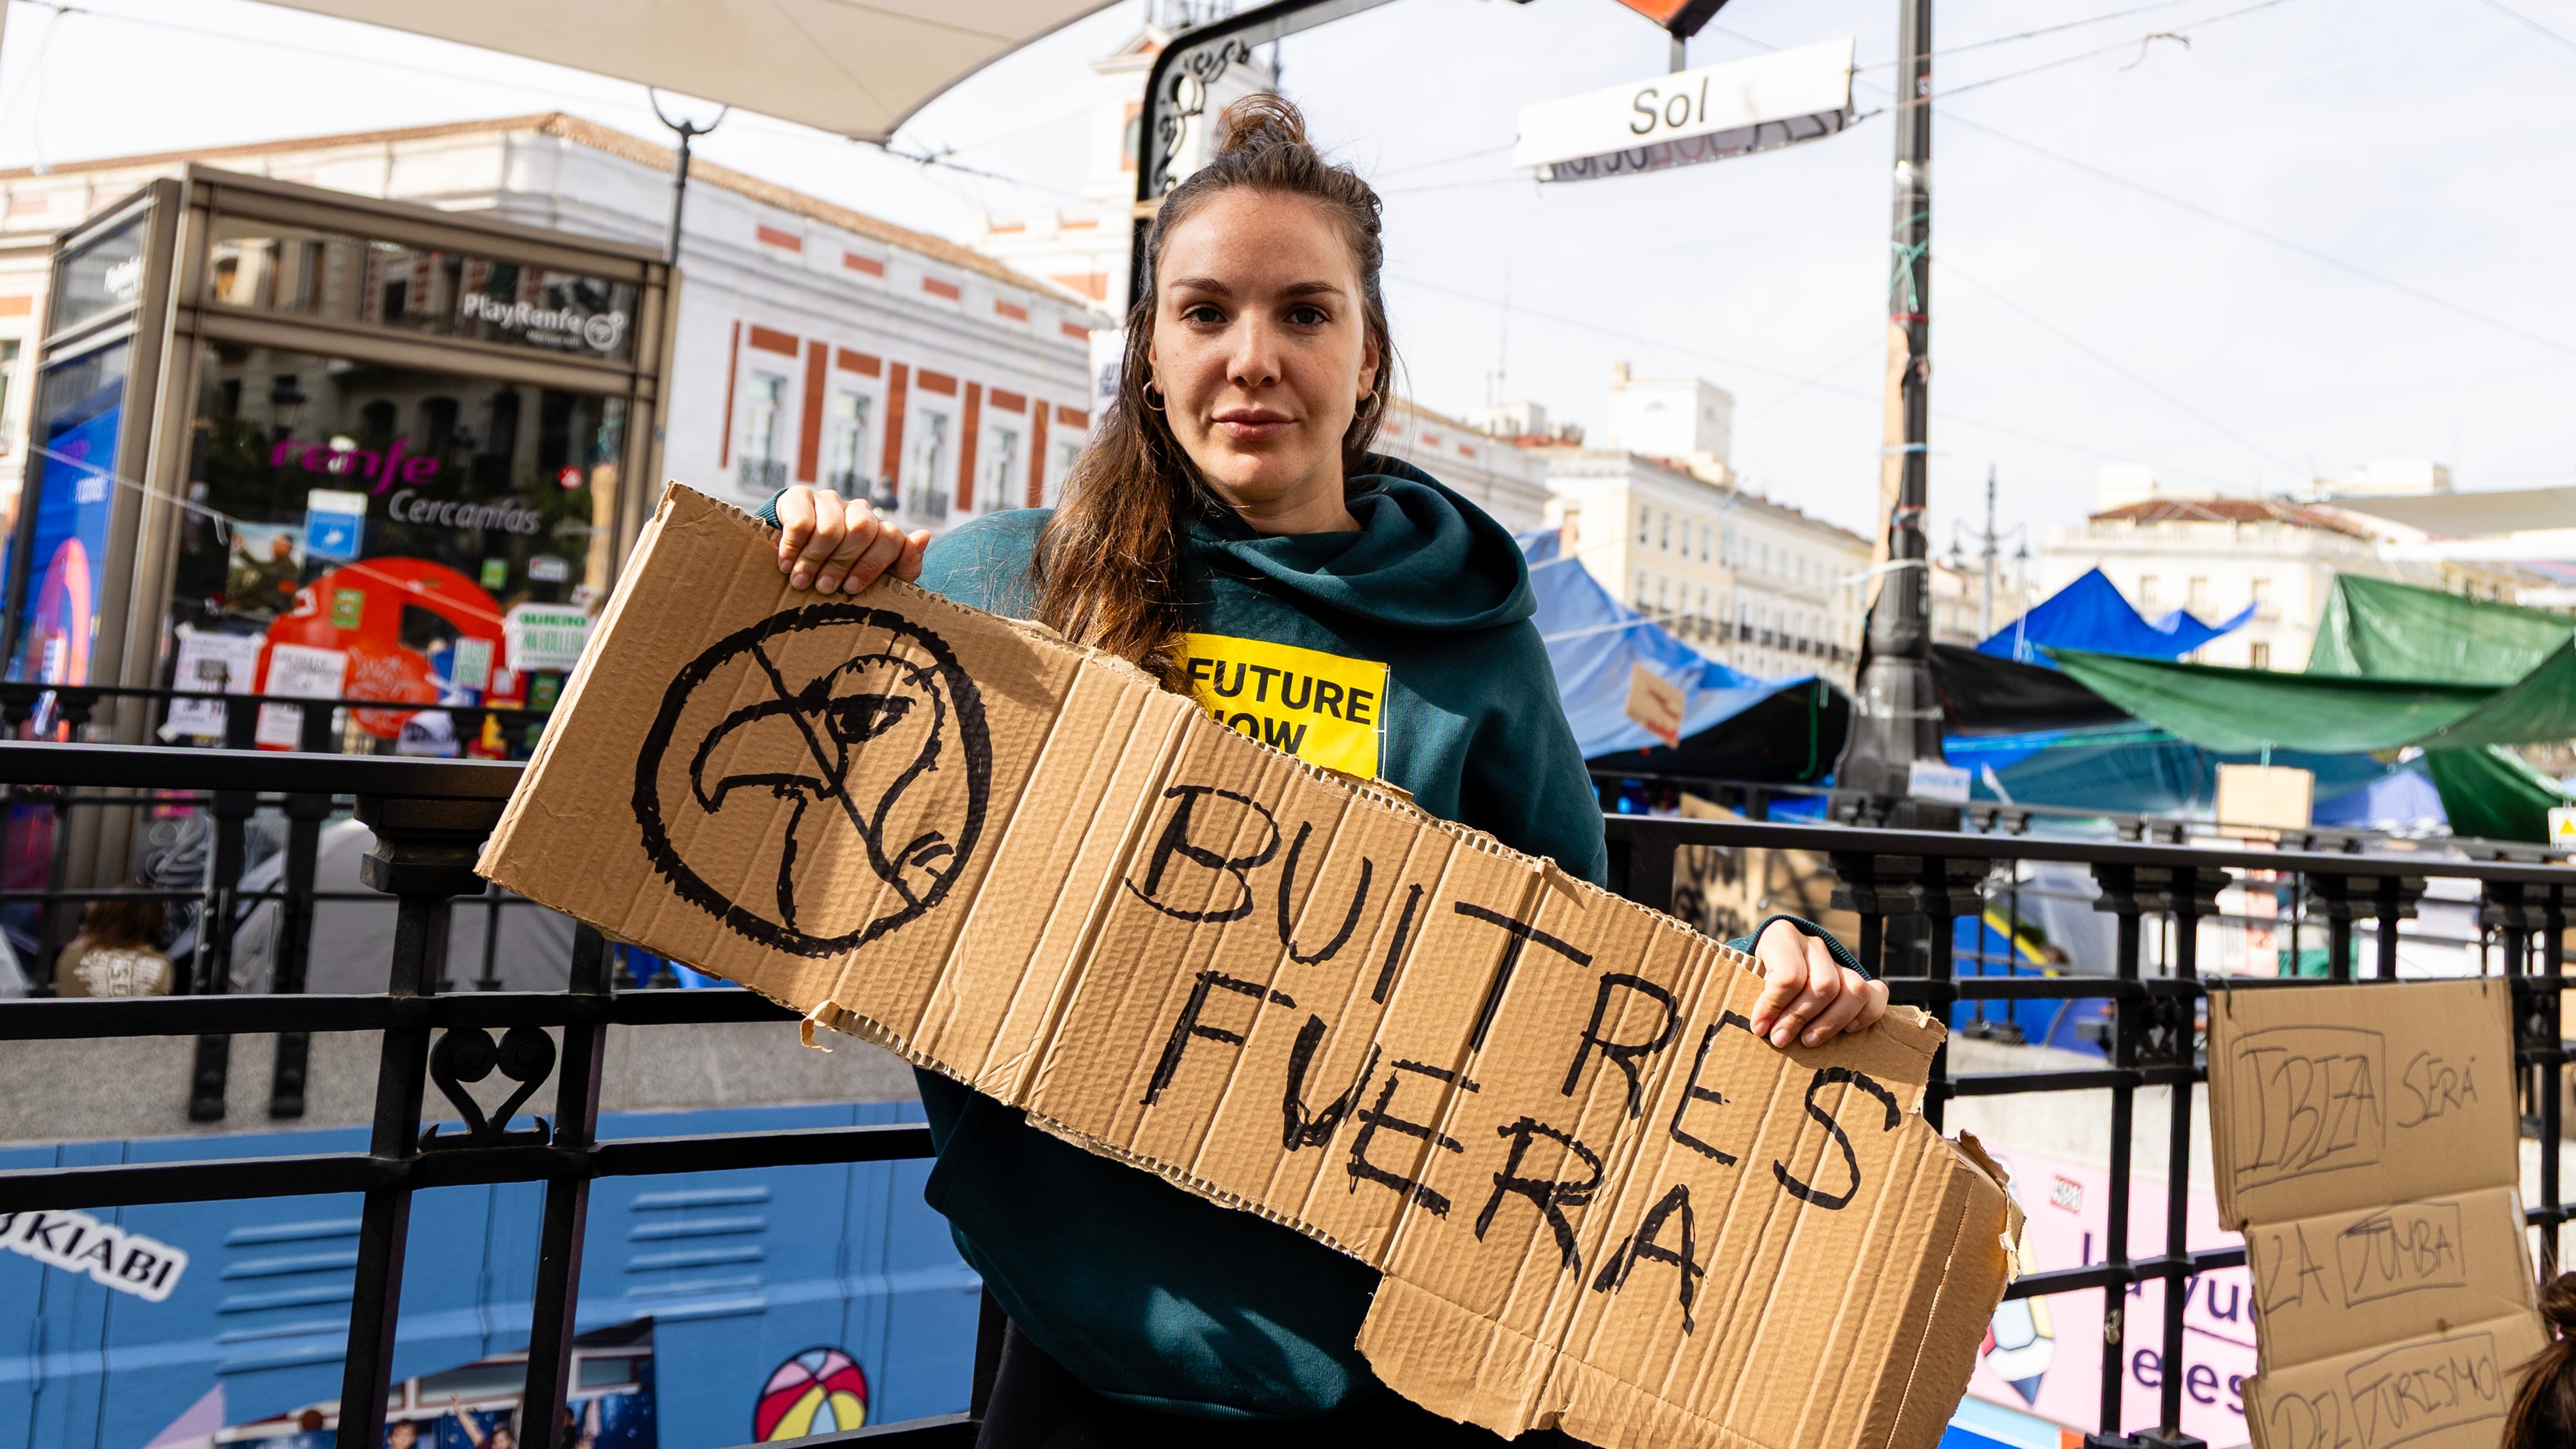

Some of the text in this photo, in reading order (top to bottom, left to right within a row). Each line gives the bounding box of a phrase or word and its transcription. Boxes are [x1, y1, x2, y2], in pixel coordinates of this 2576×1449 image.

[1630, 77, 1709, 135] Sol
[463, 293, 586, 335] PlayRenfe
[269, 437, 441, 496] renfe
[1187, 657, 1374, 725] FUTURE
[1213, 709, 1308, 754] OW
[1125, 785, 1901, 1211] BUITRES
[1139, 970, 1708, 1337] FUERA
[24, 1213, 173, 1290] KIABI
